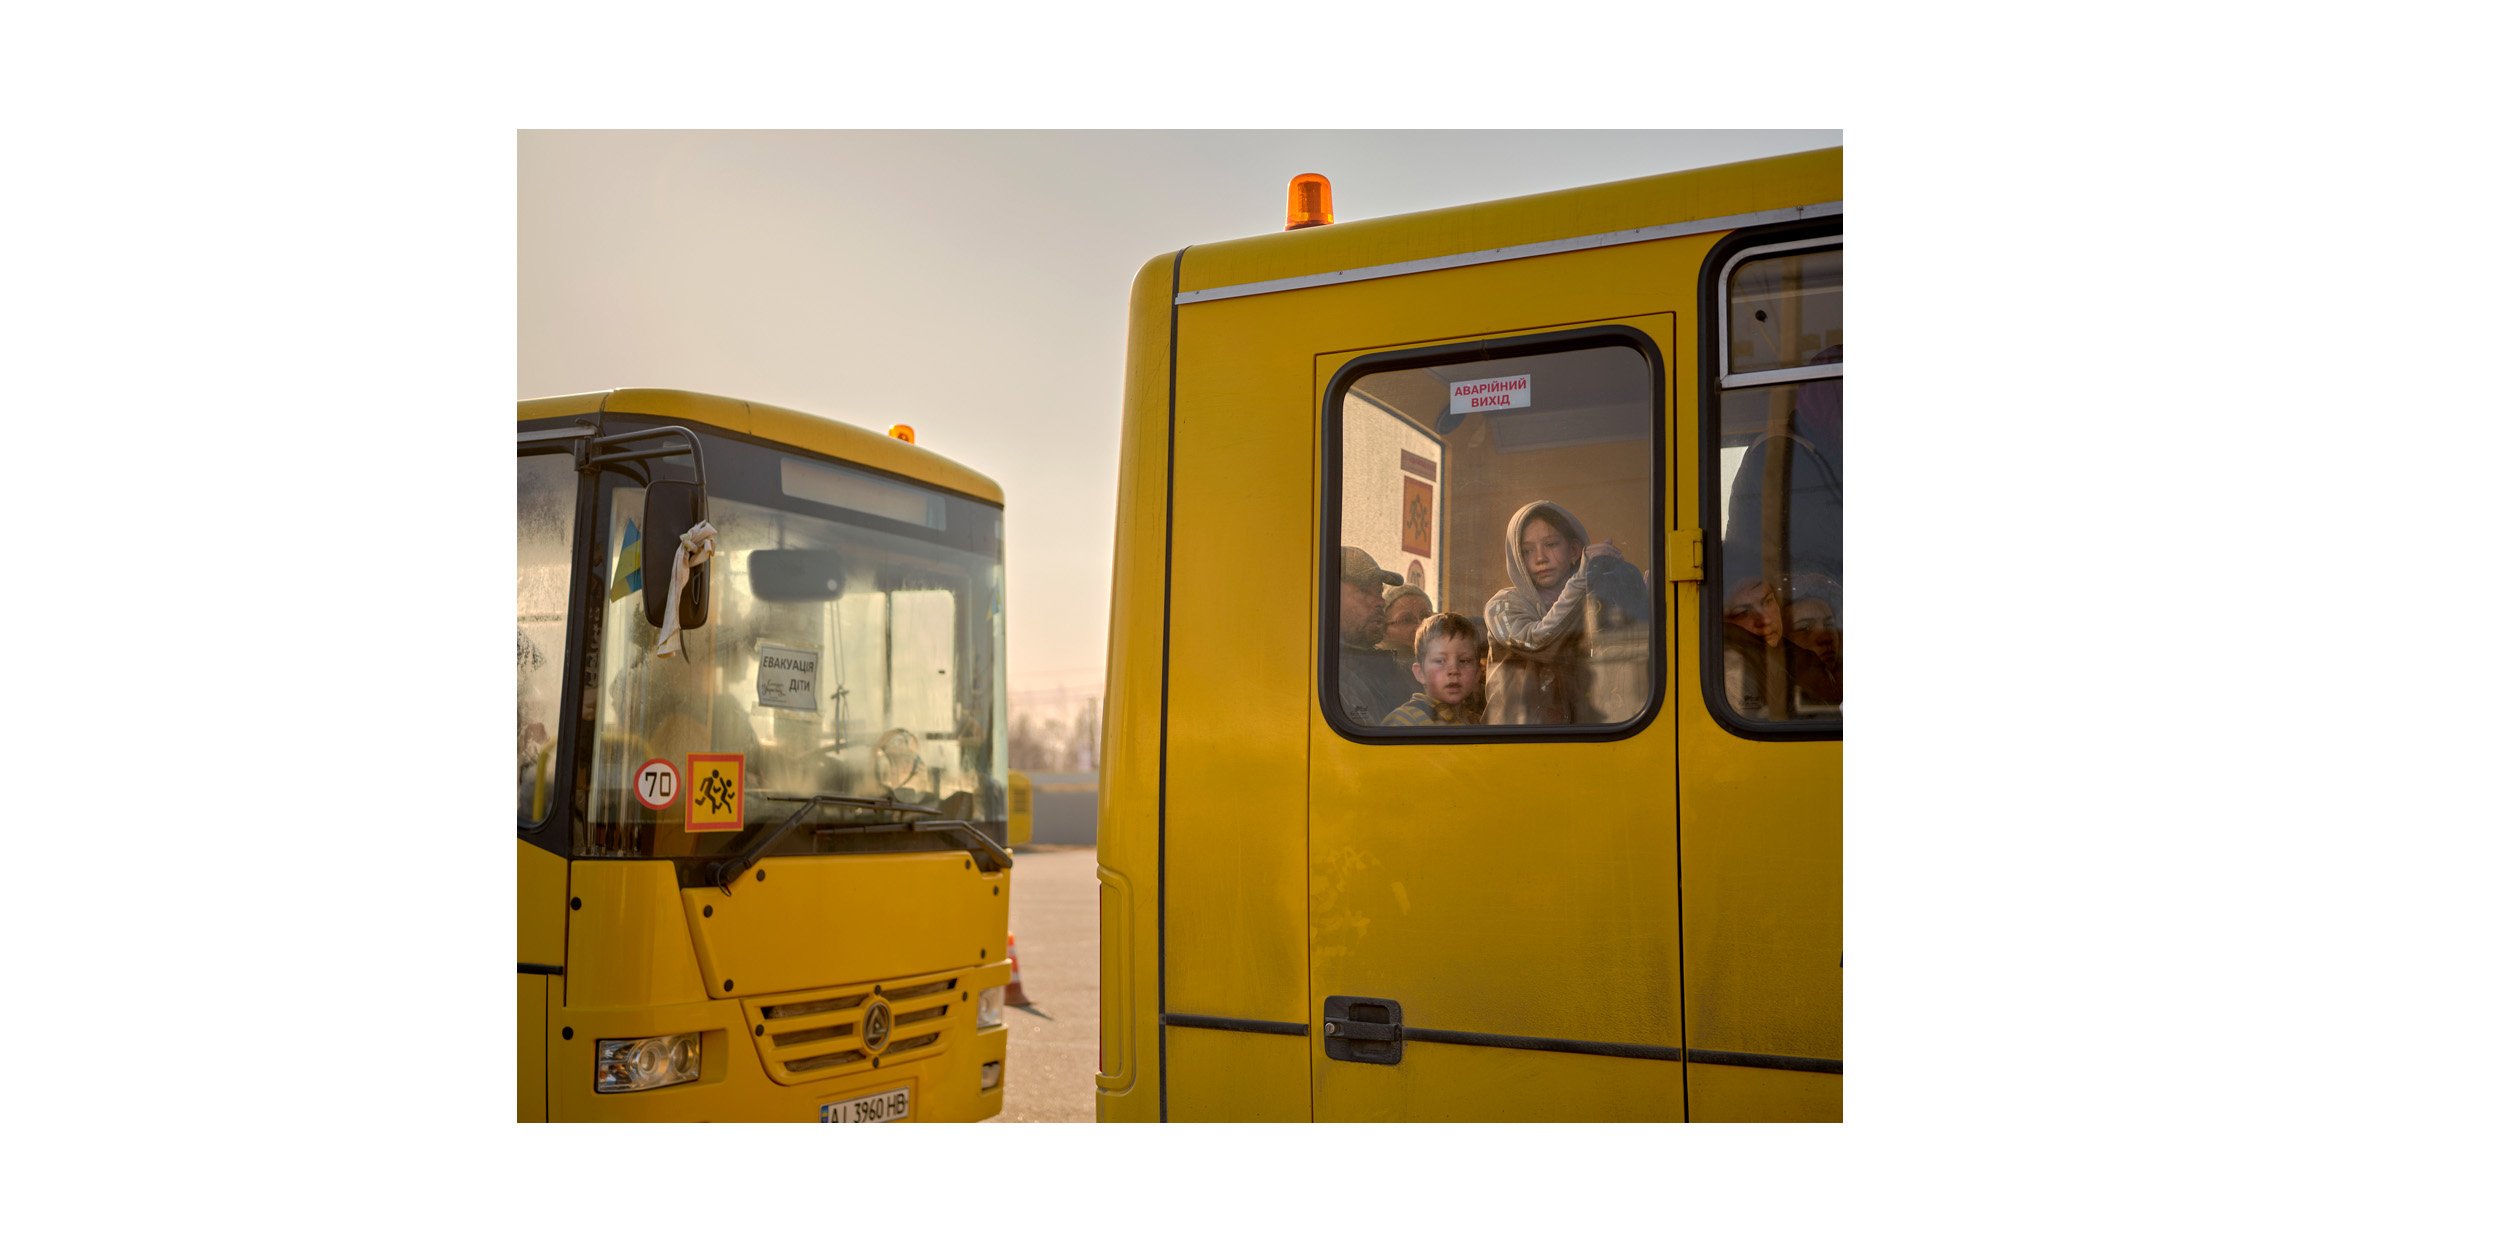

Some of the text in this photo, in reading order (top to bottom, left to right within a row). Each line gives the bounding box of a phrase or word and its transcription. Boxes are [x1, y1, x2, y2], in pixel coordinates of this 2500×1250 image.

[1455, 377, 1527, 397] АВАРІЙНИЙ
[1471, 394, 1511, 408] ВИХІД
[763, 655, 815, 674] ЕВАКУАЦІЯ
[789, 678, 811, 693] ДІТИ
[645, 771, 672, 798] 70
[853, 1098, 884, 1123] 3960
[886, 1093, 906, 1117] HB
